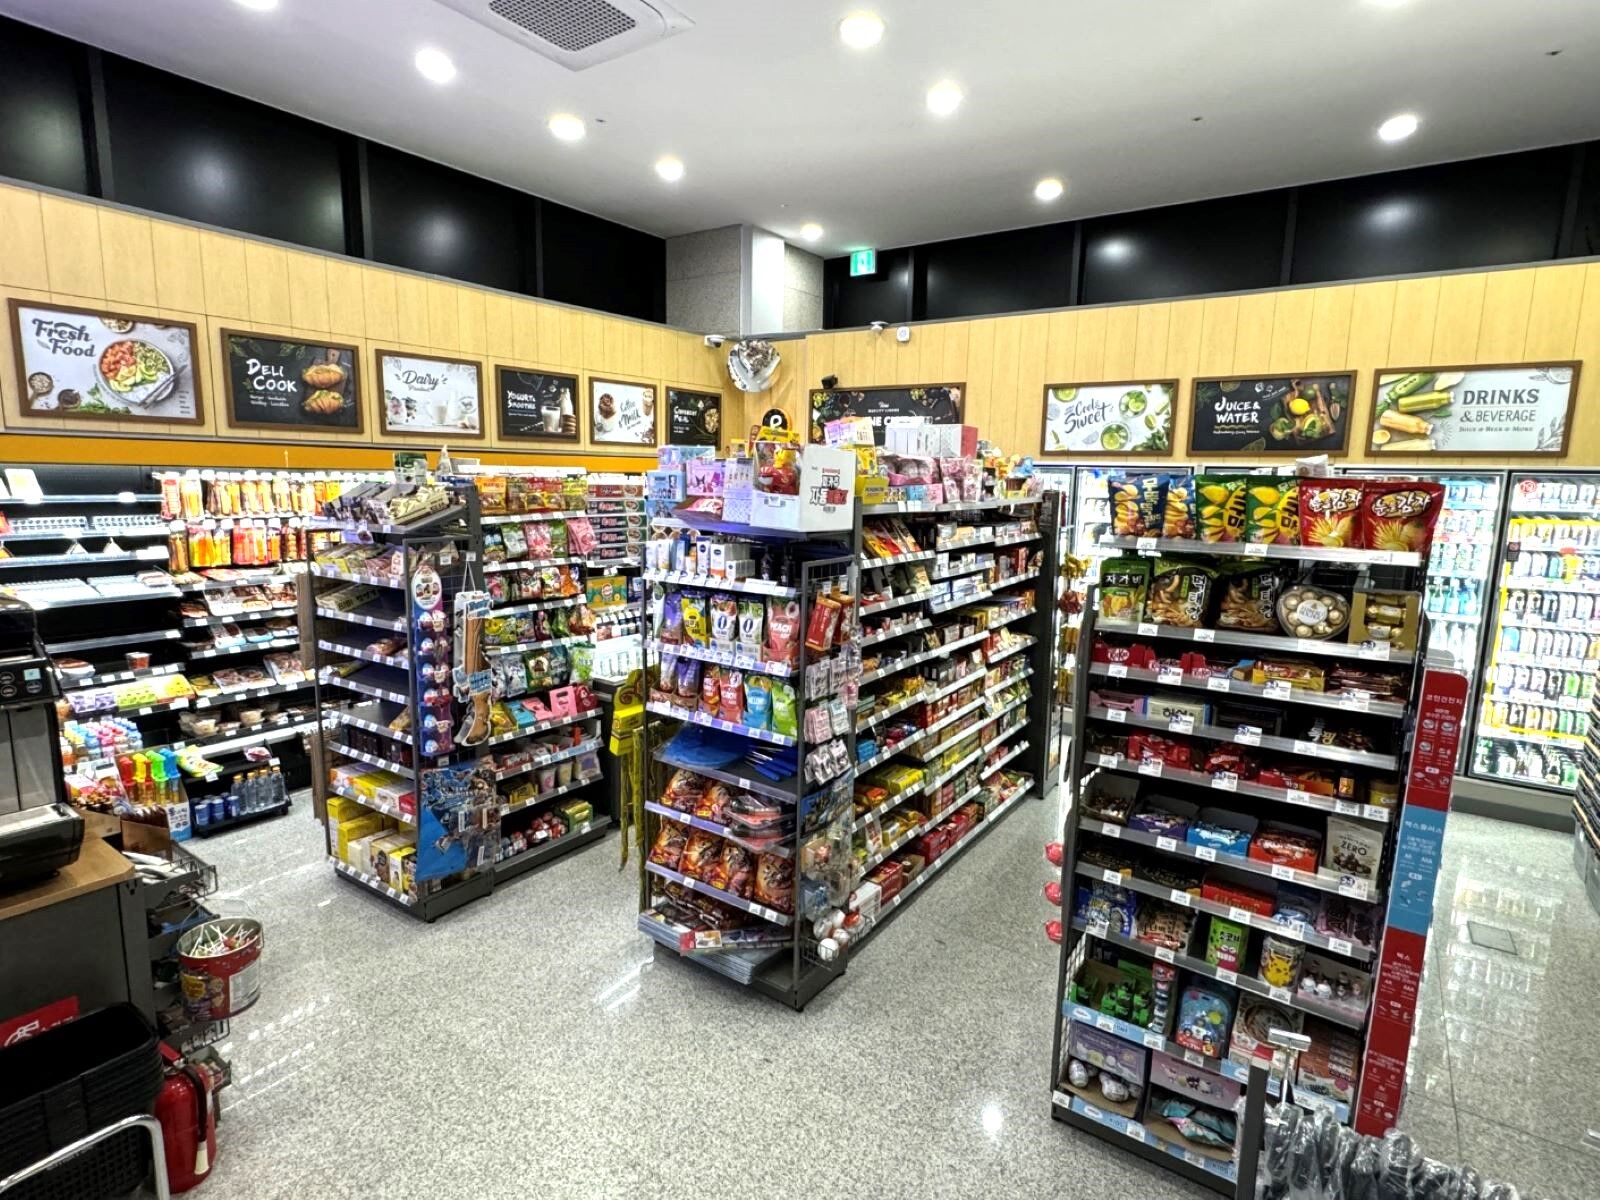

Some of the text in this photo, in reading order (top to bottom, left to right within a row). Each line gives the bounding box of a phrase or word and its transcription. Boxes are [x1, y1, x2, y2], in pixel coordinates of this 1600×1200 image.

[32, 318, 92, 342] Fresh
[49, 338, 96, 357] Food
[1462, 389, 1540, 405] DRINKS
[1064, 402, 1111, 434] Sweet
[1216, 411, 1259, 424] WATER
[1460, 410, 1536, 423] & BEVERAGE
[1340, 841, 1367, 856] ZERO
